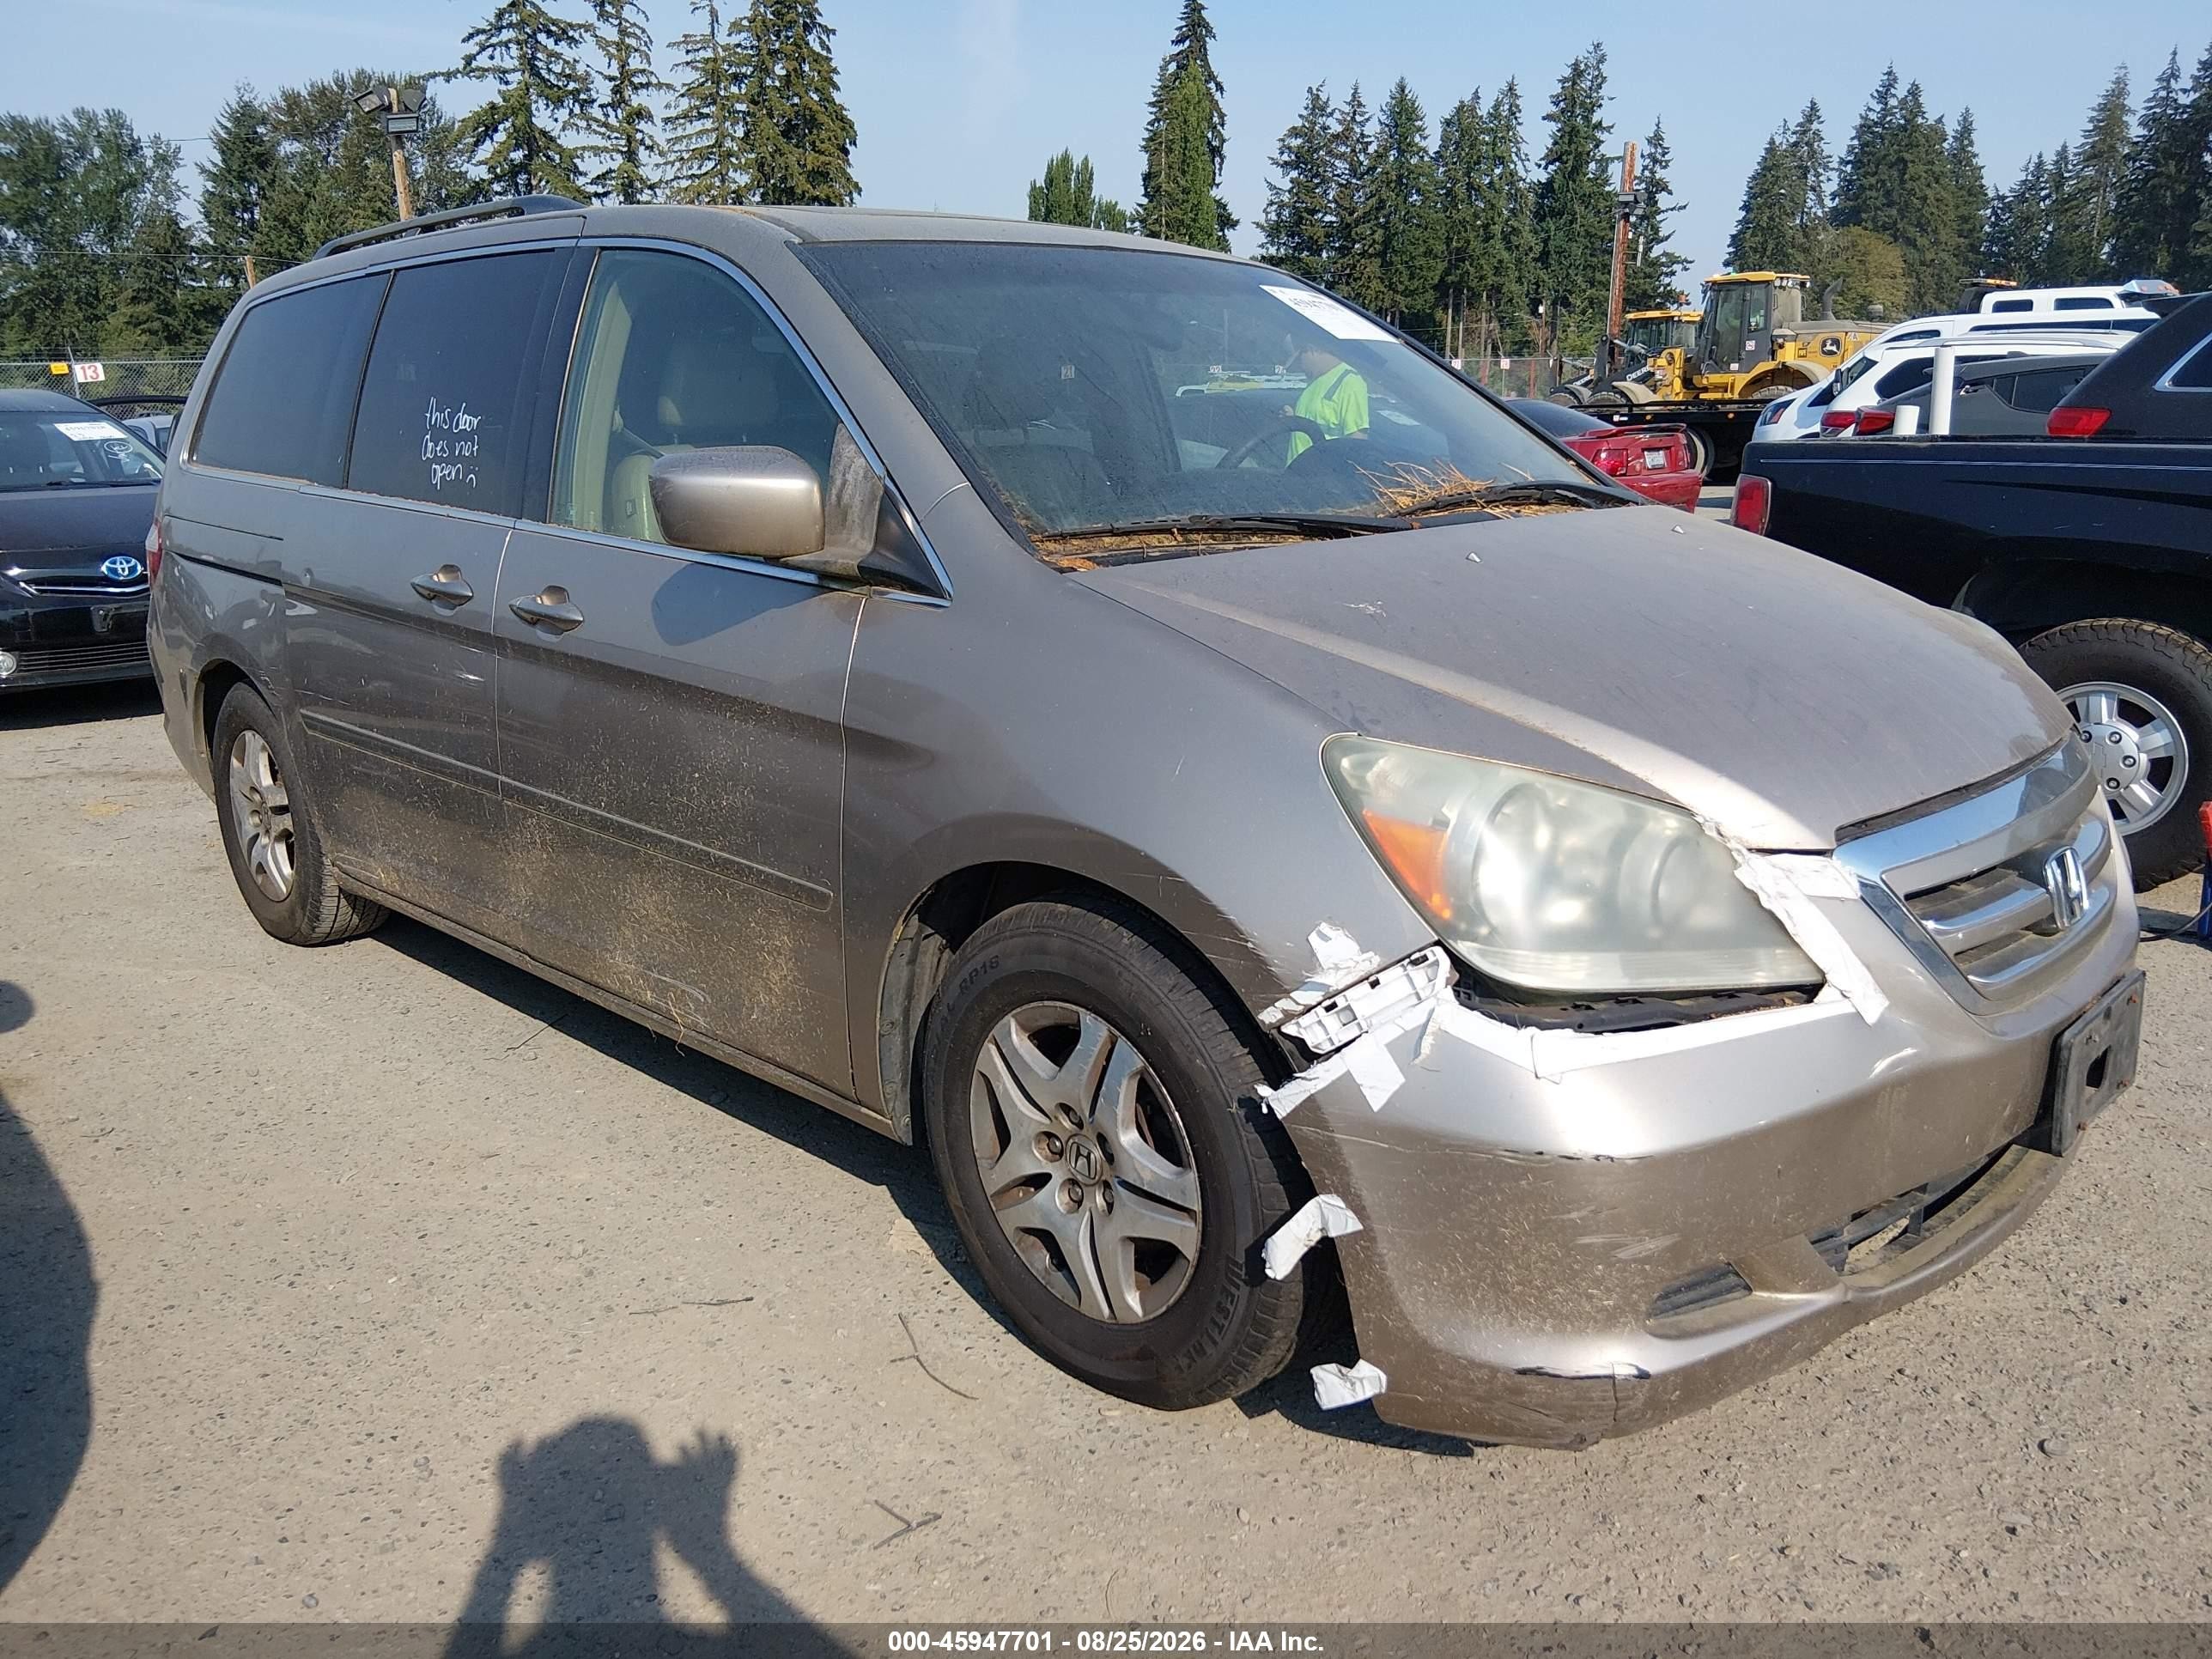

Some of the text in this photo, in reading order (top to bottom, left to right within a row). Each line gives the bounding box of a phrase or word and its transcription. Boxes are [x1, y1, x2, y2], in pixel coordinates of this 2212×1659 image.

[81, 364, 100, 380] 13
[425, 397, 482, 433] this door
[422, 430, 478, 460] does not
[431, 463, 463, 489] open
